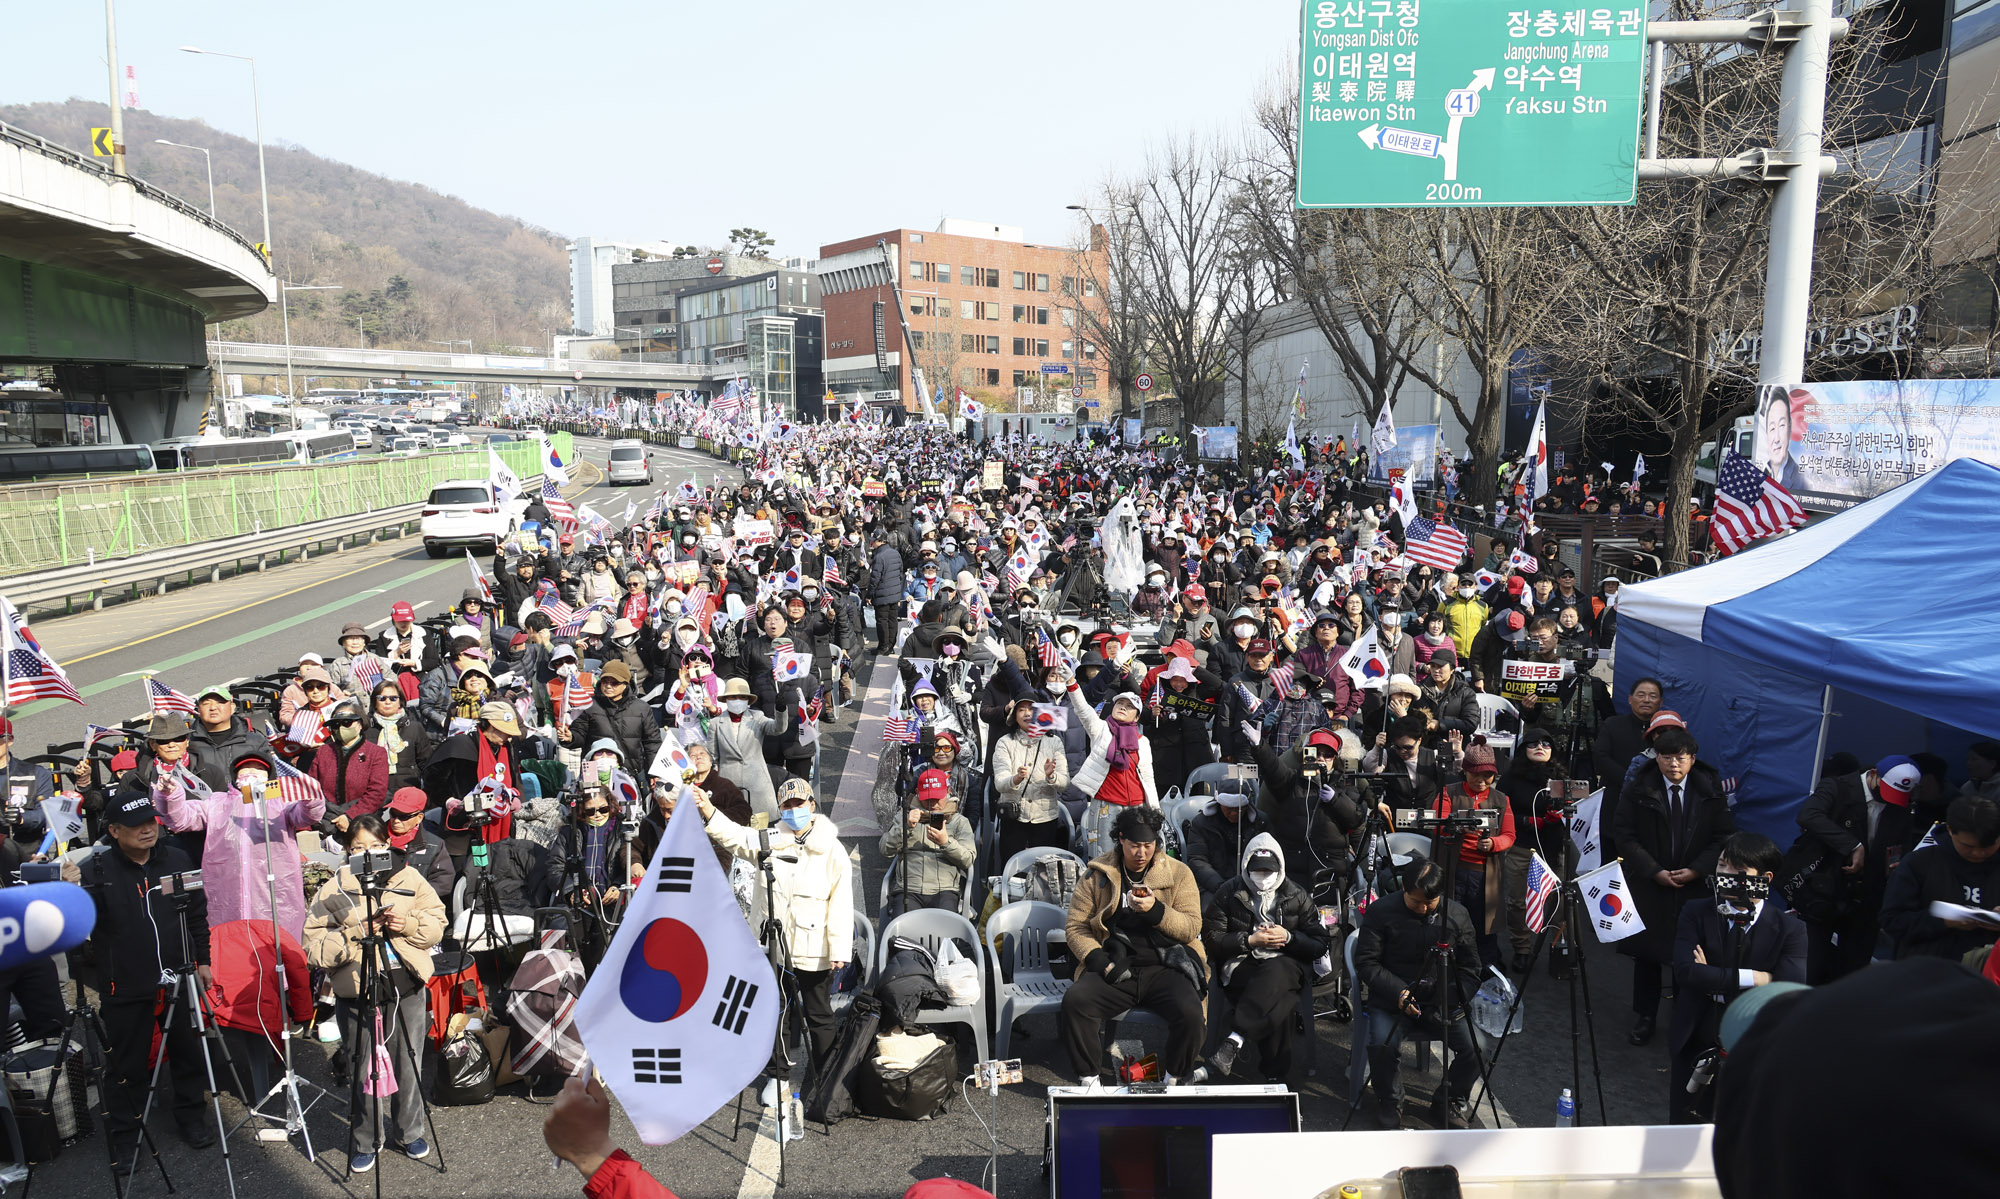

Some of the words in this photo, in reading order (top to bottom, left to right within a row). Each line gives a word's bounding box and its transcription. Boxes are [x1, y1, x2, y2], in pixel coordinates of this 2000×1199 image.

[1313, 0, 1420, 28] 용산구청
[1505, 8, 1642, 38] 장충체육관
[1313, 29, 1366, 51] Yongsan
[1370, 29, 1396, 47] Dist
[1397, 28, 1419, 47] Ofc
[1504, 42, 1568, 64] Jangchung
[1572, 42, 1609, 60] Arena
[1313, 51, 1417, 79] 이태원역
[1503, 64, 1583, 92] 약수역
[1309, 105, 1380, 122] Itaewon
[1386, 104, 1416, 121] Stn
[1450, 93, 1475, 114] 41
[1505, 98, 1566, 115] Yaksu
[1573, 96, 1608, 114] Stn
[1387, 132, 1433, 153] 이태원로
[1426, 183, 1482, 201] 200m
[1139, 379, 1149, 387] 60
[1801, 430, 1853, 452] 자유민주주의
[1855, 432, 1903, 455] 대한민국의
[1907, 435, 1934, 458] 희망!
[1799, 455, 1824, 475] 윤석열
[1825, 457, 1871, 477] 대통령님의
[750, 536, 772, 545] FREE
[1506, 665, 1561, 680] 탄핵무효
[1505, 681, 1537, 694] 이재명
[1537, 682, 1558, 694] 구속
[1167, 695, 1214, 713] 돌아와요!
[122, 797, 151, 812] 대한민국
